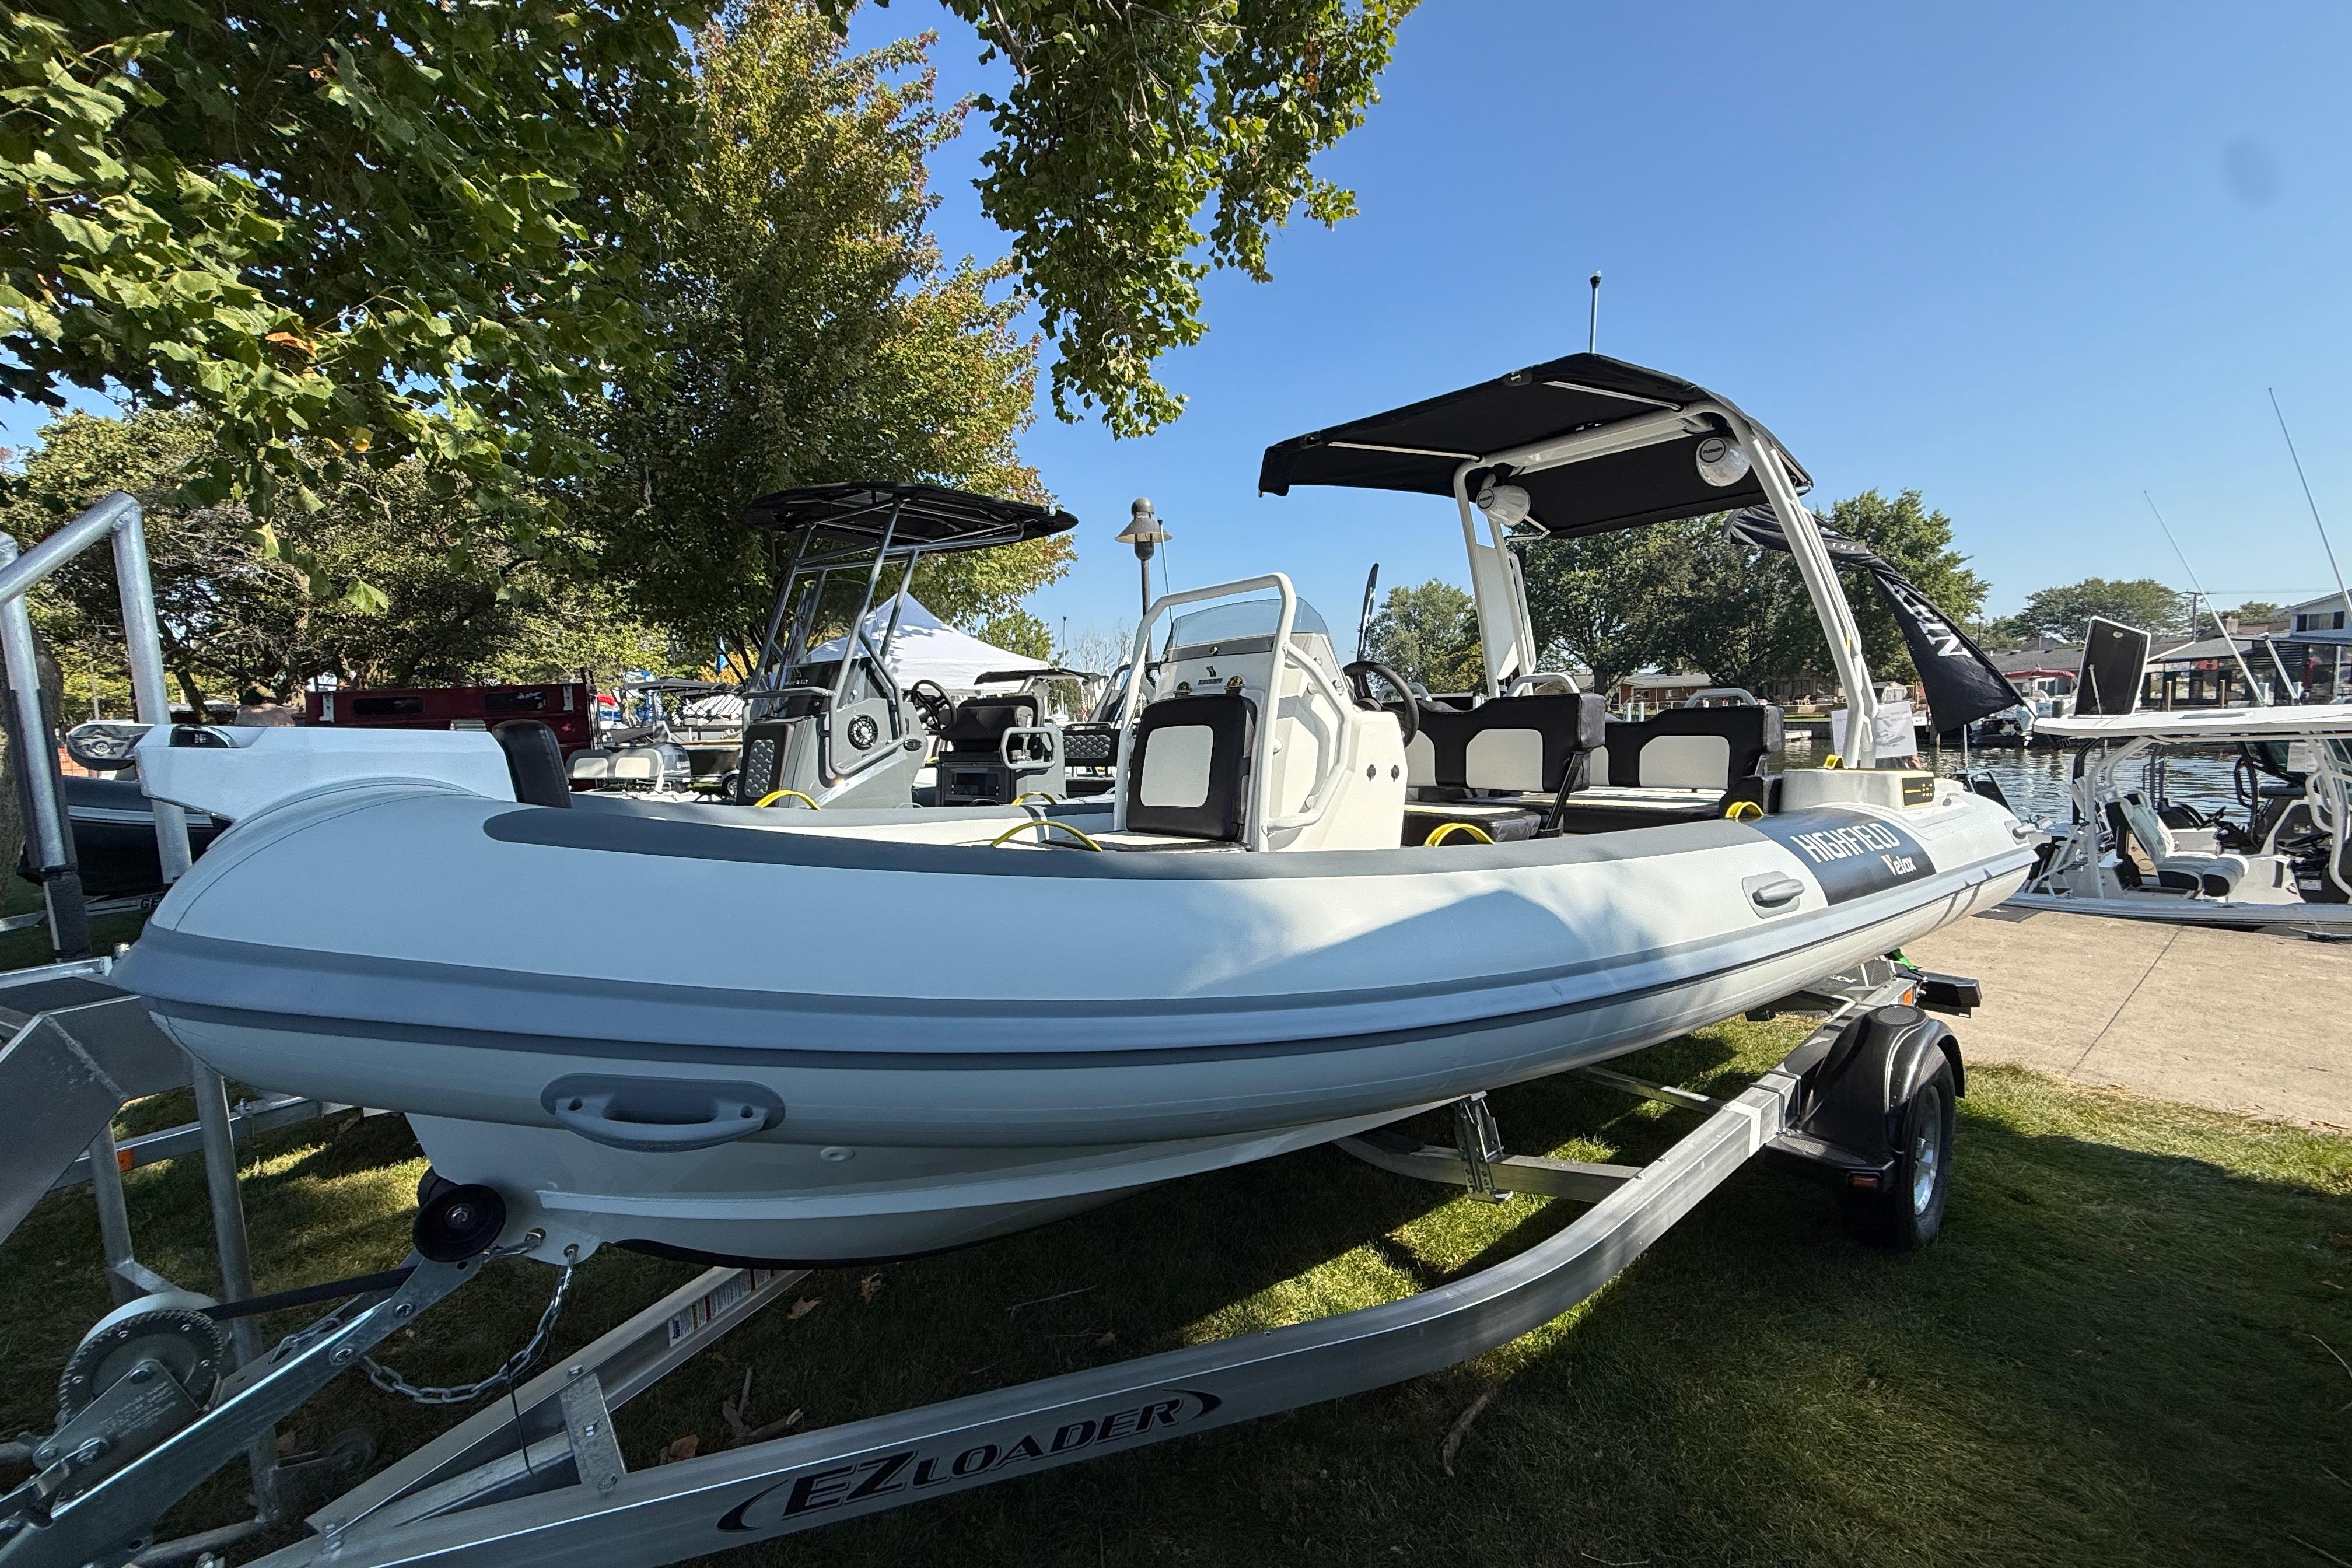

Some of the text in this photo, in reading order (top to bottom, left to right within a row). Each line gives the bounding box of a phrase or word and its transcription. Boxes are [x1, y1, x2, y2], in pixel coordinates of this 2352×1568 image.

[1832, 542, 1856, 551] THE
[1790, 823, 1901, 863] HIGHFIELD
[1880, 854, 1917, 876] Velox
